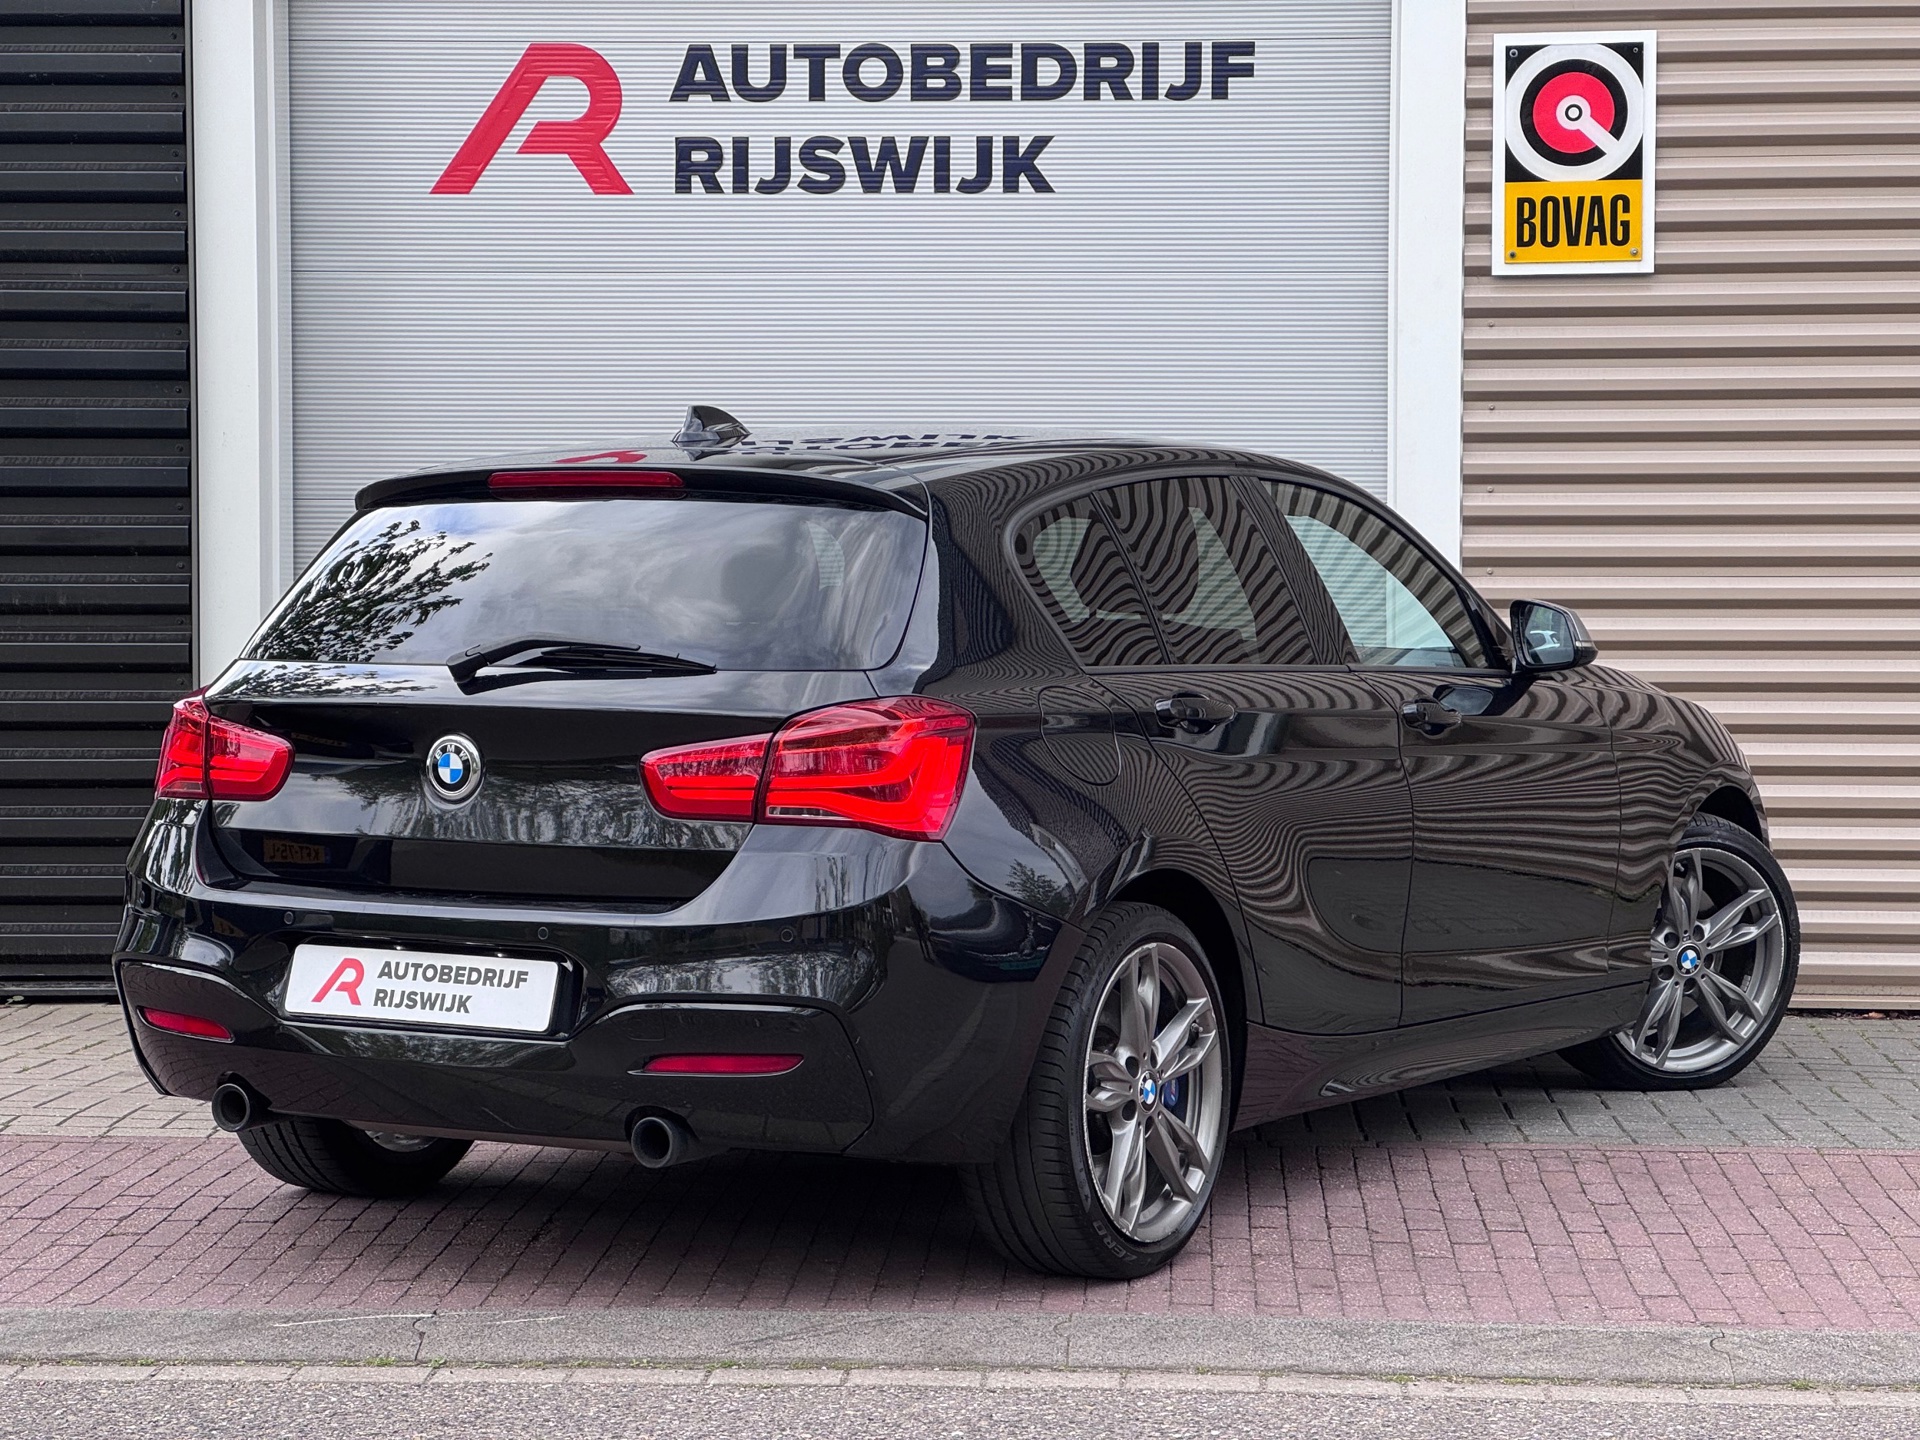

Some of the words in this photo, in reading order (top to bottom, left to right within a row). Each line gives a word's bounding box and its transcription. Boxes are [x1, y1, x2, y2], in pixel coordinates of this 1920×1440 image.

[669, 41, 1256, 102] AUTOBEDRIJF
[674, 135, 1056, 194] RIJSWIJK
[1516, 194, 1631, 248] BOVAG
[434, 744, 469, 761] BMW
[377, 961, 529, 988] AUTOBEDRIJF
[373, 989, 473, 1014] RIJSWIJK
[1092, 1220, 1138, 1261] ZERO
